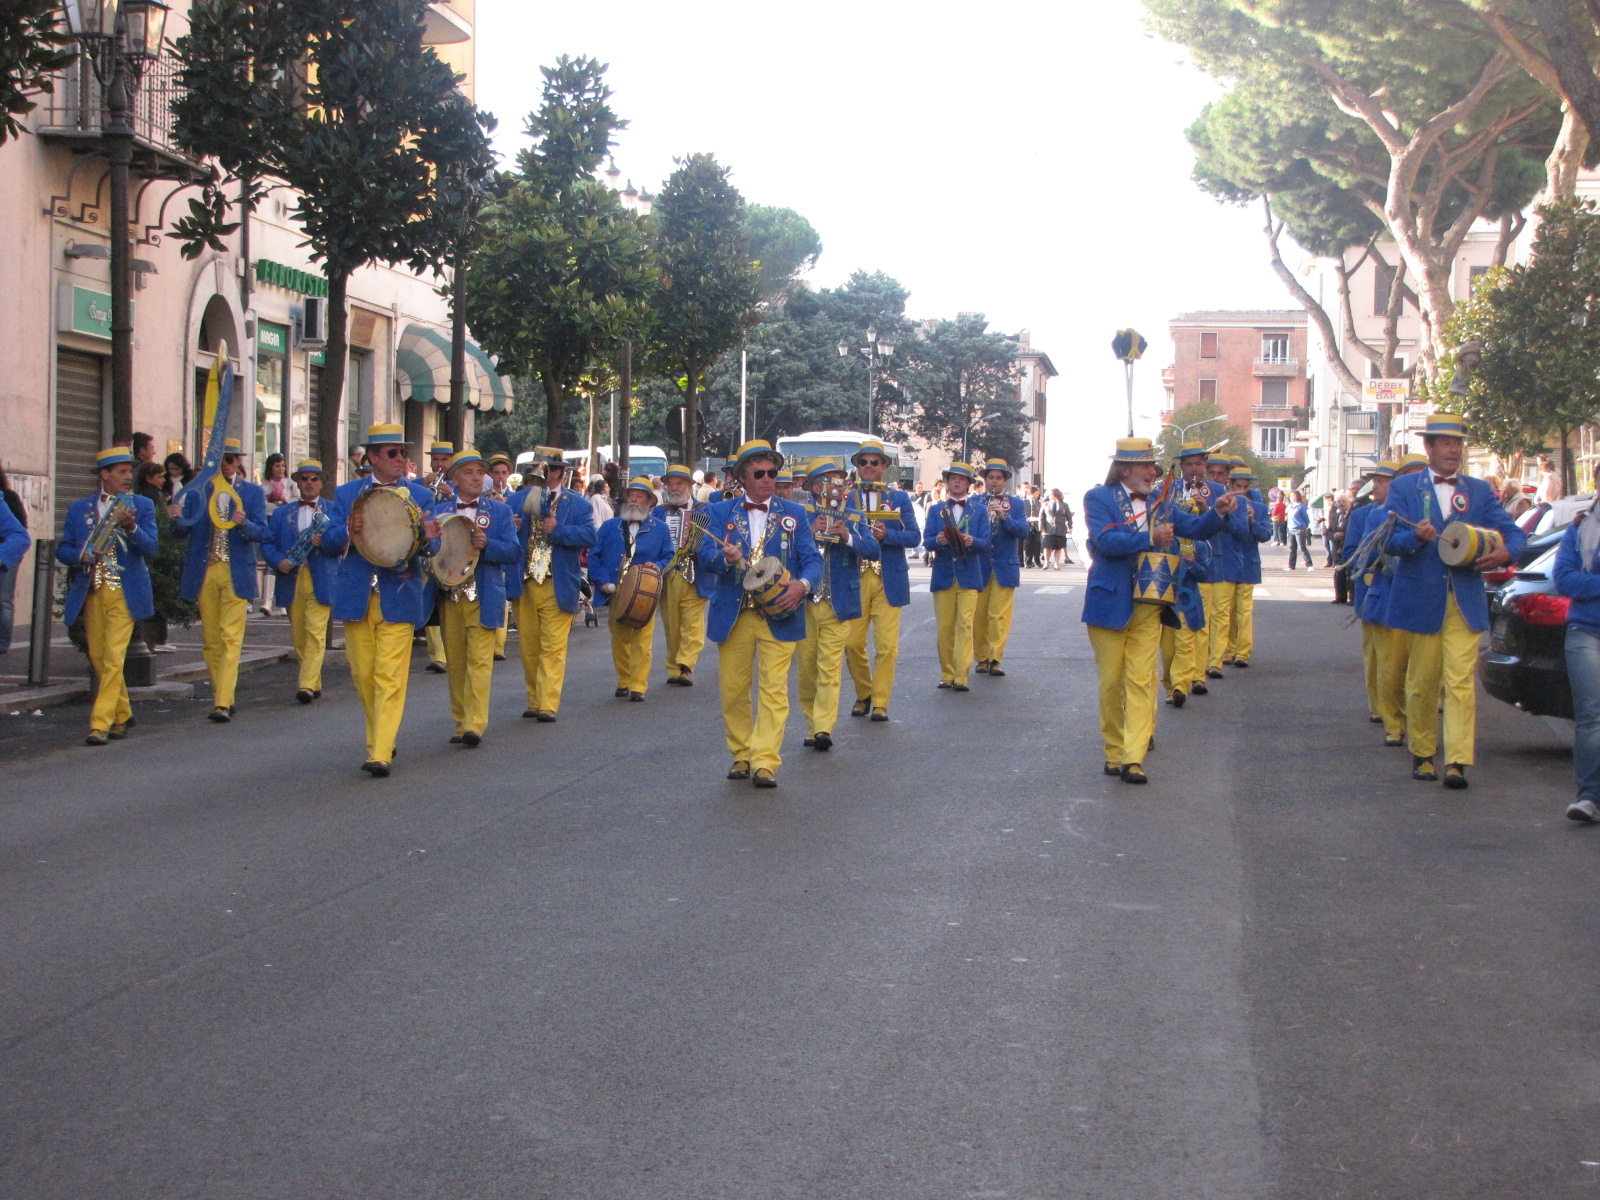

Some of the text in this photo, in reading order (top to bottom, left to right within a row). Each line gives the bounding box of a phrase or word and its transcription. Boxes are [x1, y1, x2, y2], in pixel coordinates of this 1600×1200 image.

[260, 329, 280, 347] MAGIA
[1369, 381, 1403, 390] DERBY
[1375, 392, 1396, 400] BAR
